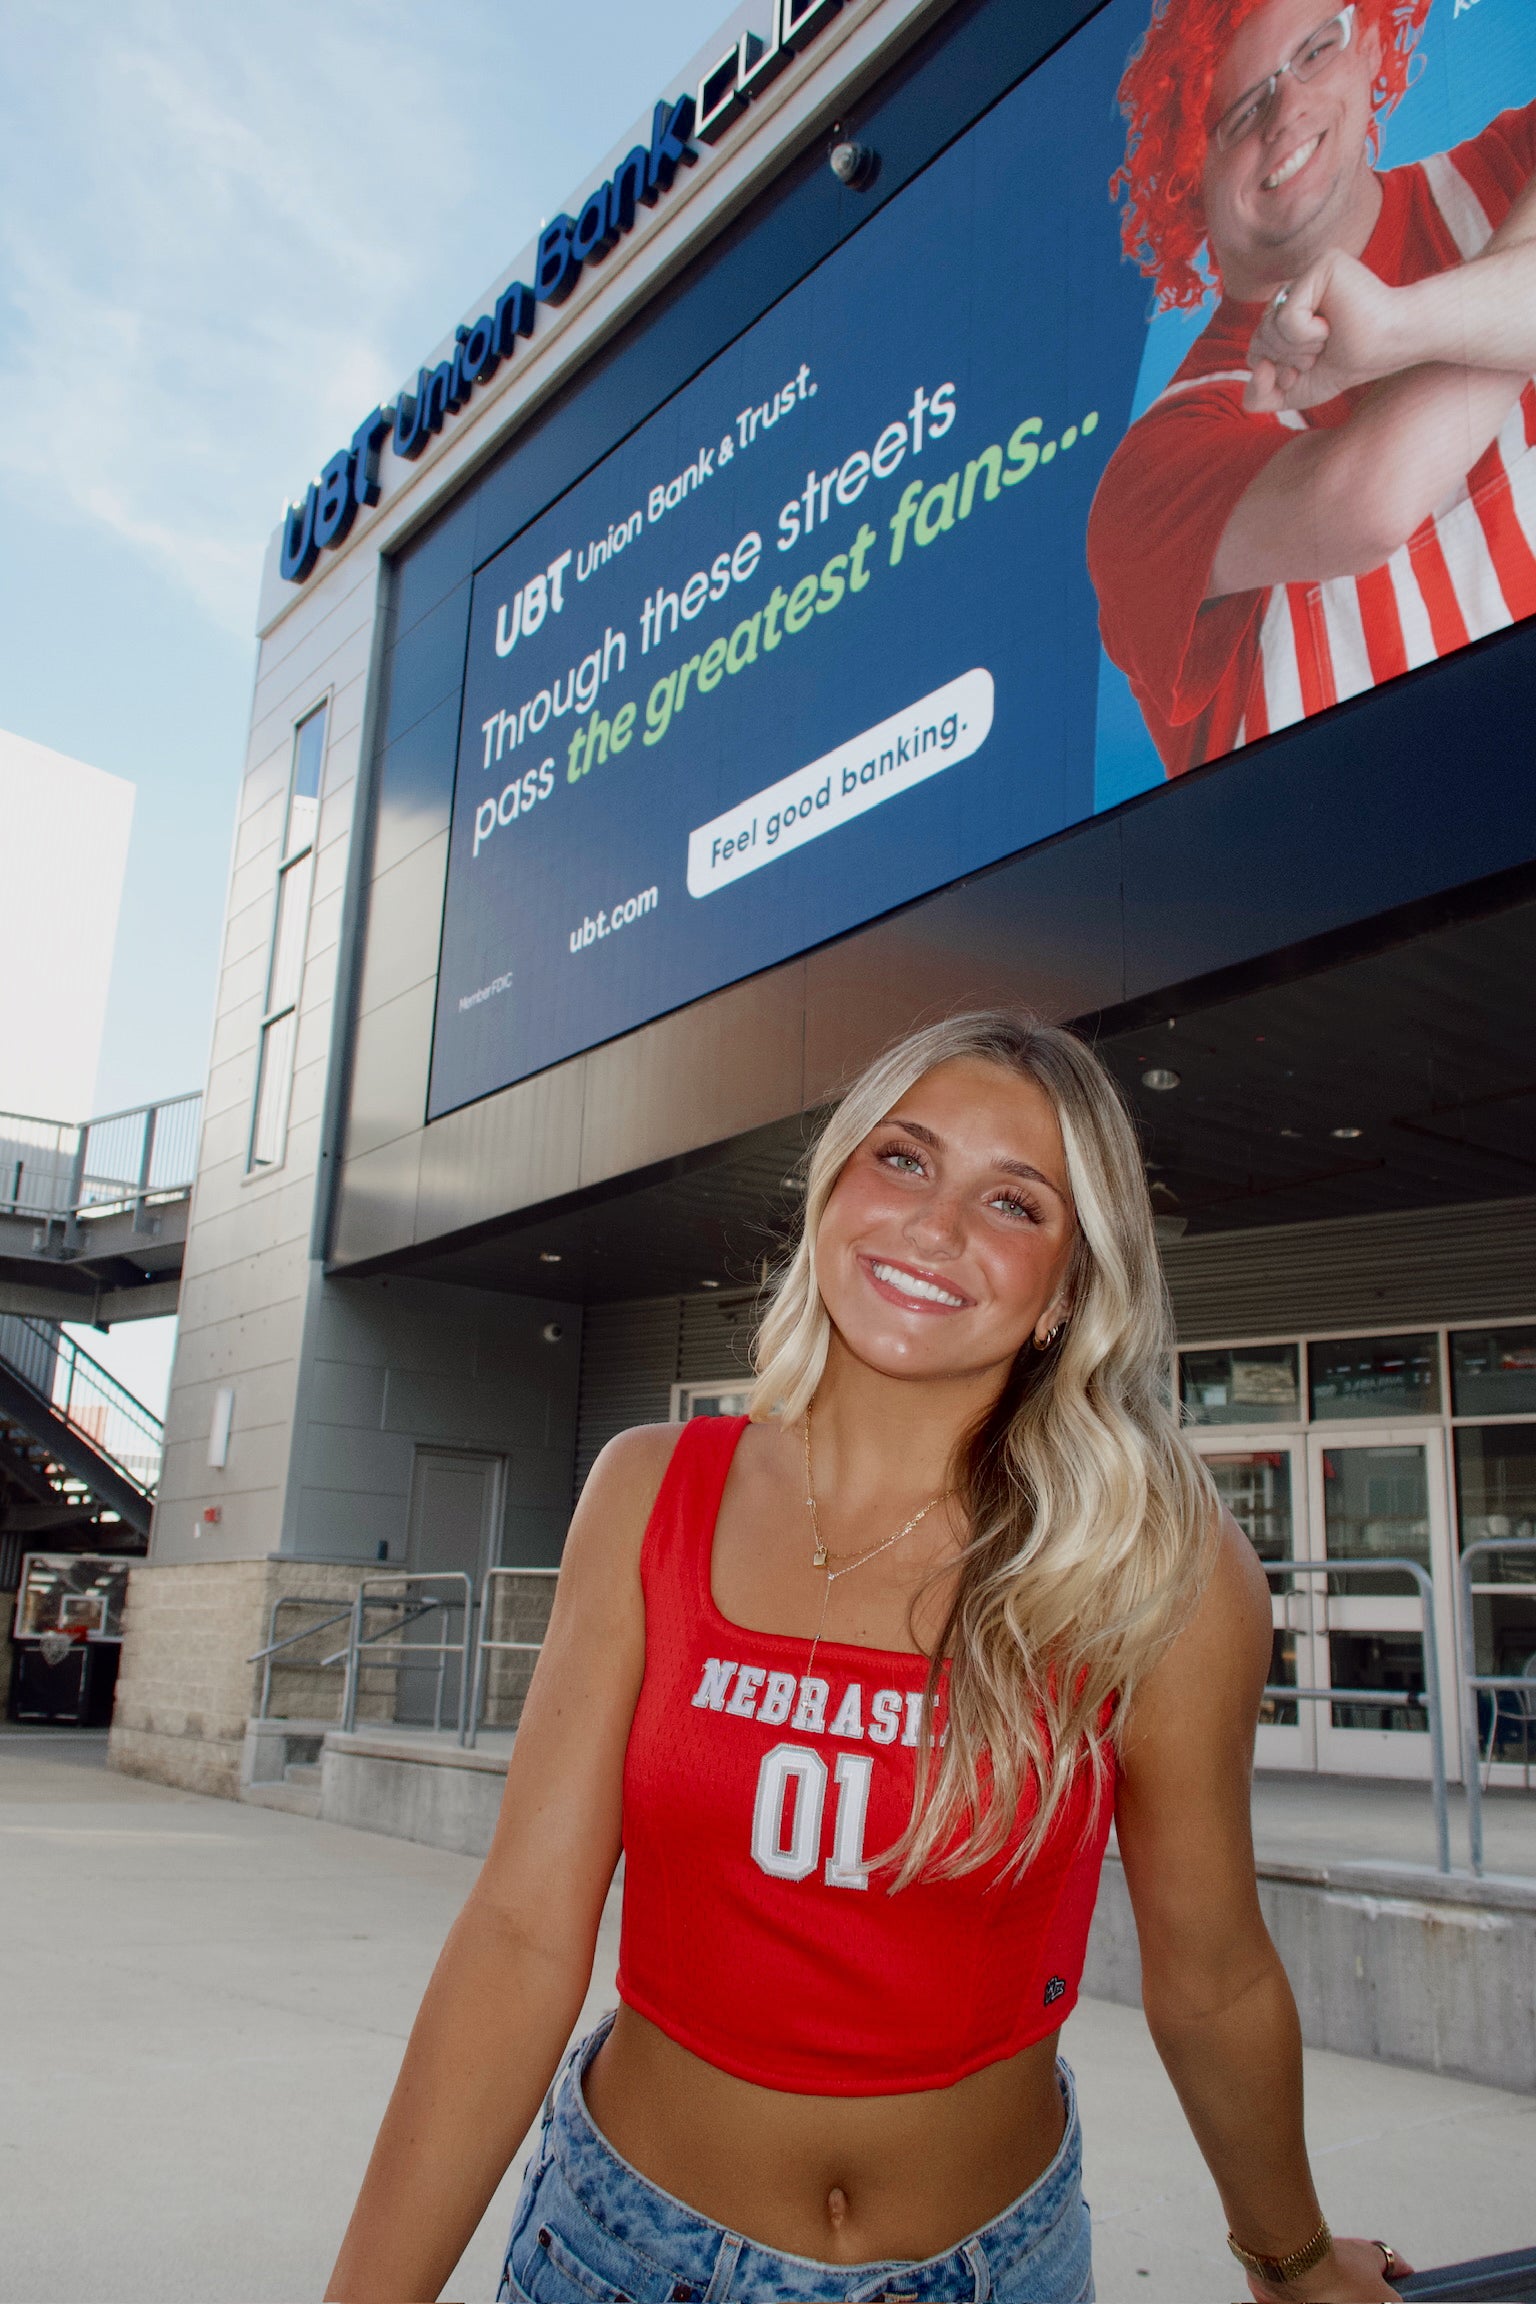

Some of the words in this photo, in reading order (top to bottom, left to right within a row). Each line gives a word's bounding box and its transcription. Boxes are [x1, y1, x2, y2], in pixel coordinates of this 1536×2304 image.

[280, 402, 388, 582] UBT
[393, 281, 531, 461] Union
[535, 93, 690, 304] Bank
[481, 626, 626, 770] Through
[639, 531, 762, 654] these
[777, 381, 956, 551] streets
[495, 549, 572, 657] UBT
[577, 510, 643, 581] Union
[647, 447, 715, 523] Bank
[717, 434, 734, 466] &
[737, 363, 818, 448] Trust.
[472, 757, 555, 859] pass
[567, 701, 636, 783] the
[643, 523, 876, 745] greatest
[889, 411, 1098, 566] fans...
[711, 818, 757, 868] Feel
[766, 776, 831, 844] good
[841, 712, 967, 796] banking.
[568, 885, 659, 954] ubt.com
[691, 1656, 951, 1748] NEBRASK
[750, 1741, 874, 1891] 01
